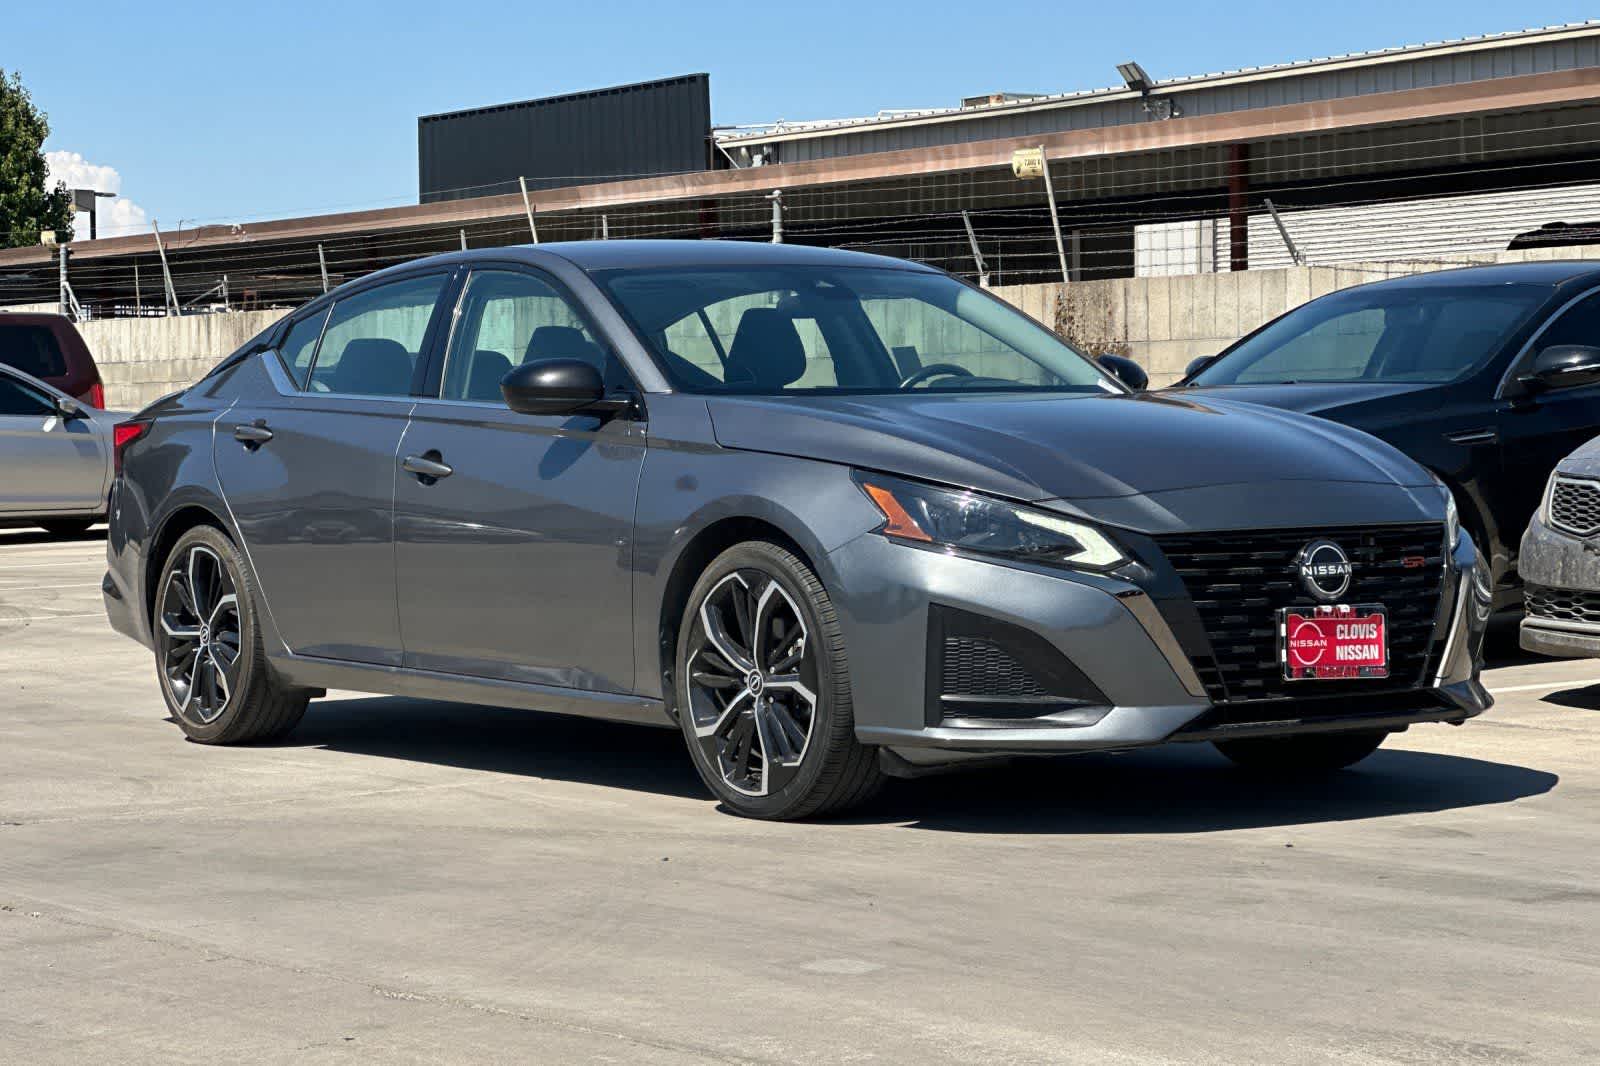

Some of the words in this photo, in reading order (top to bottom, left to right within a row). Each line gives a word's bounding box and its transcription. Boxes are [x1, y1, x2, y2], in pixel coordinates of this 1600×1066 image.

[1302, 564, 1352, 576] NISSAN
[1336, 623, 1378, 640] CLOVIS
[1290, 639, 1328, 648] NISSAN
[1336, 644, 1379, 660] NISSAN
